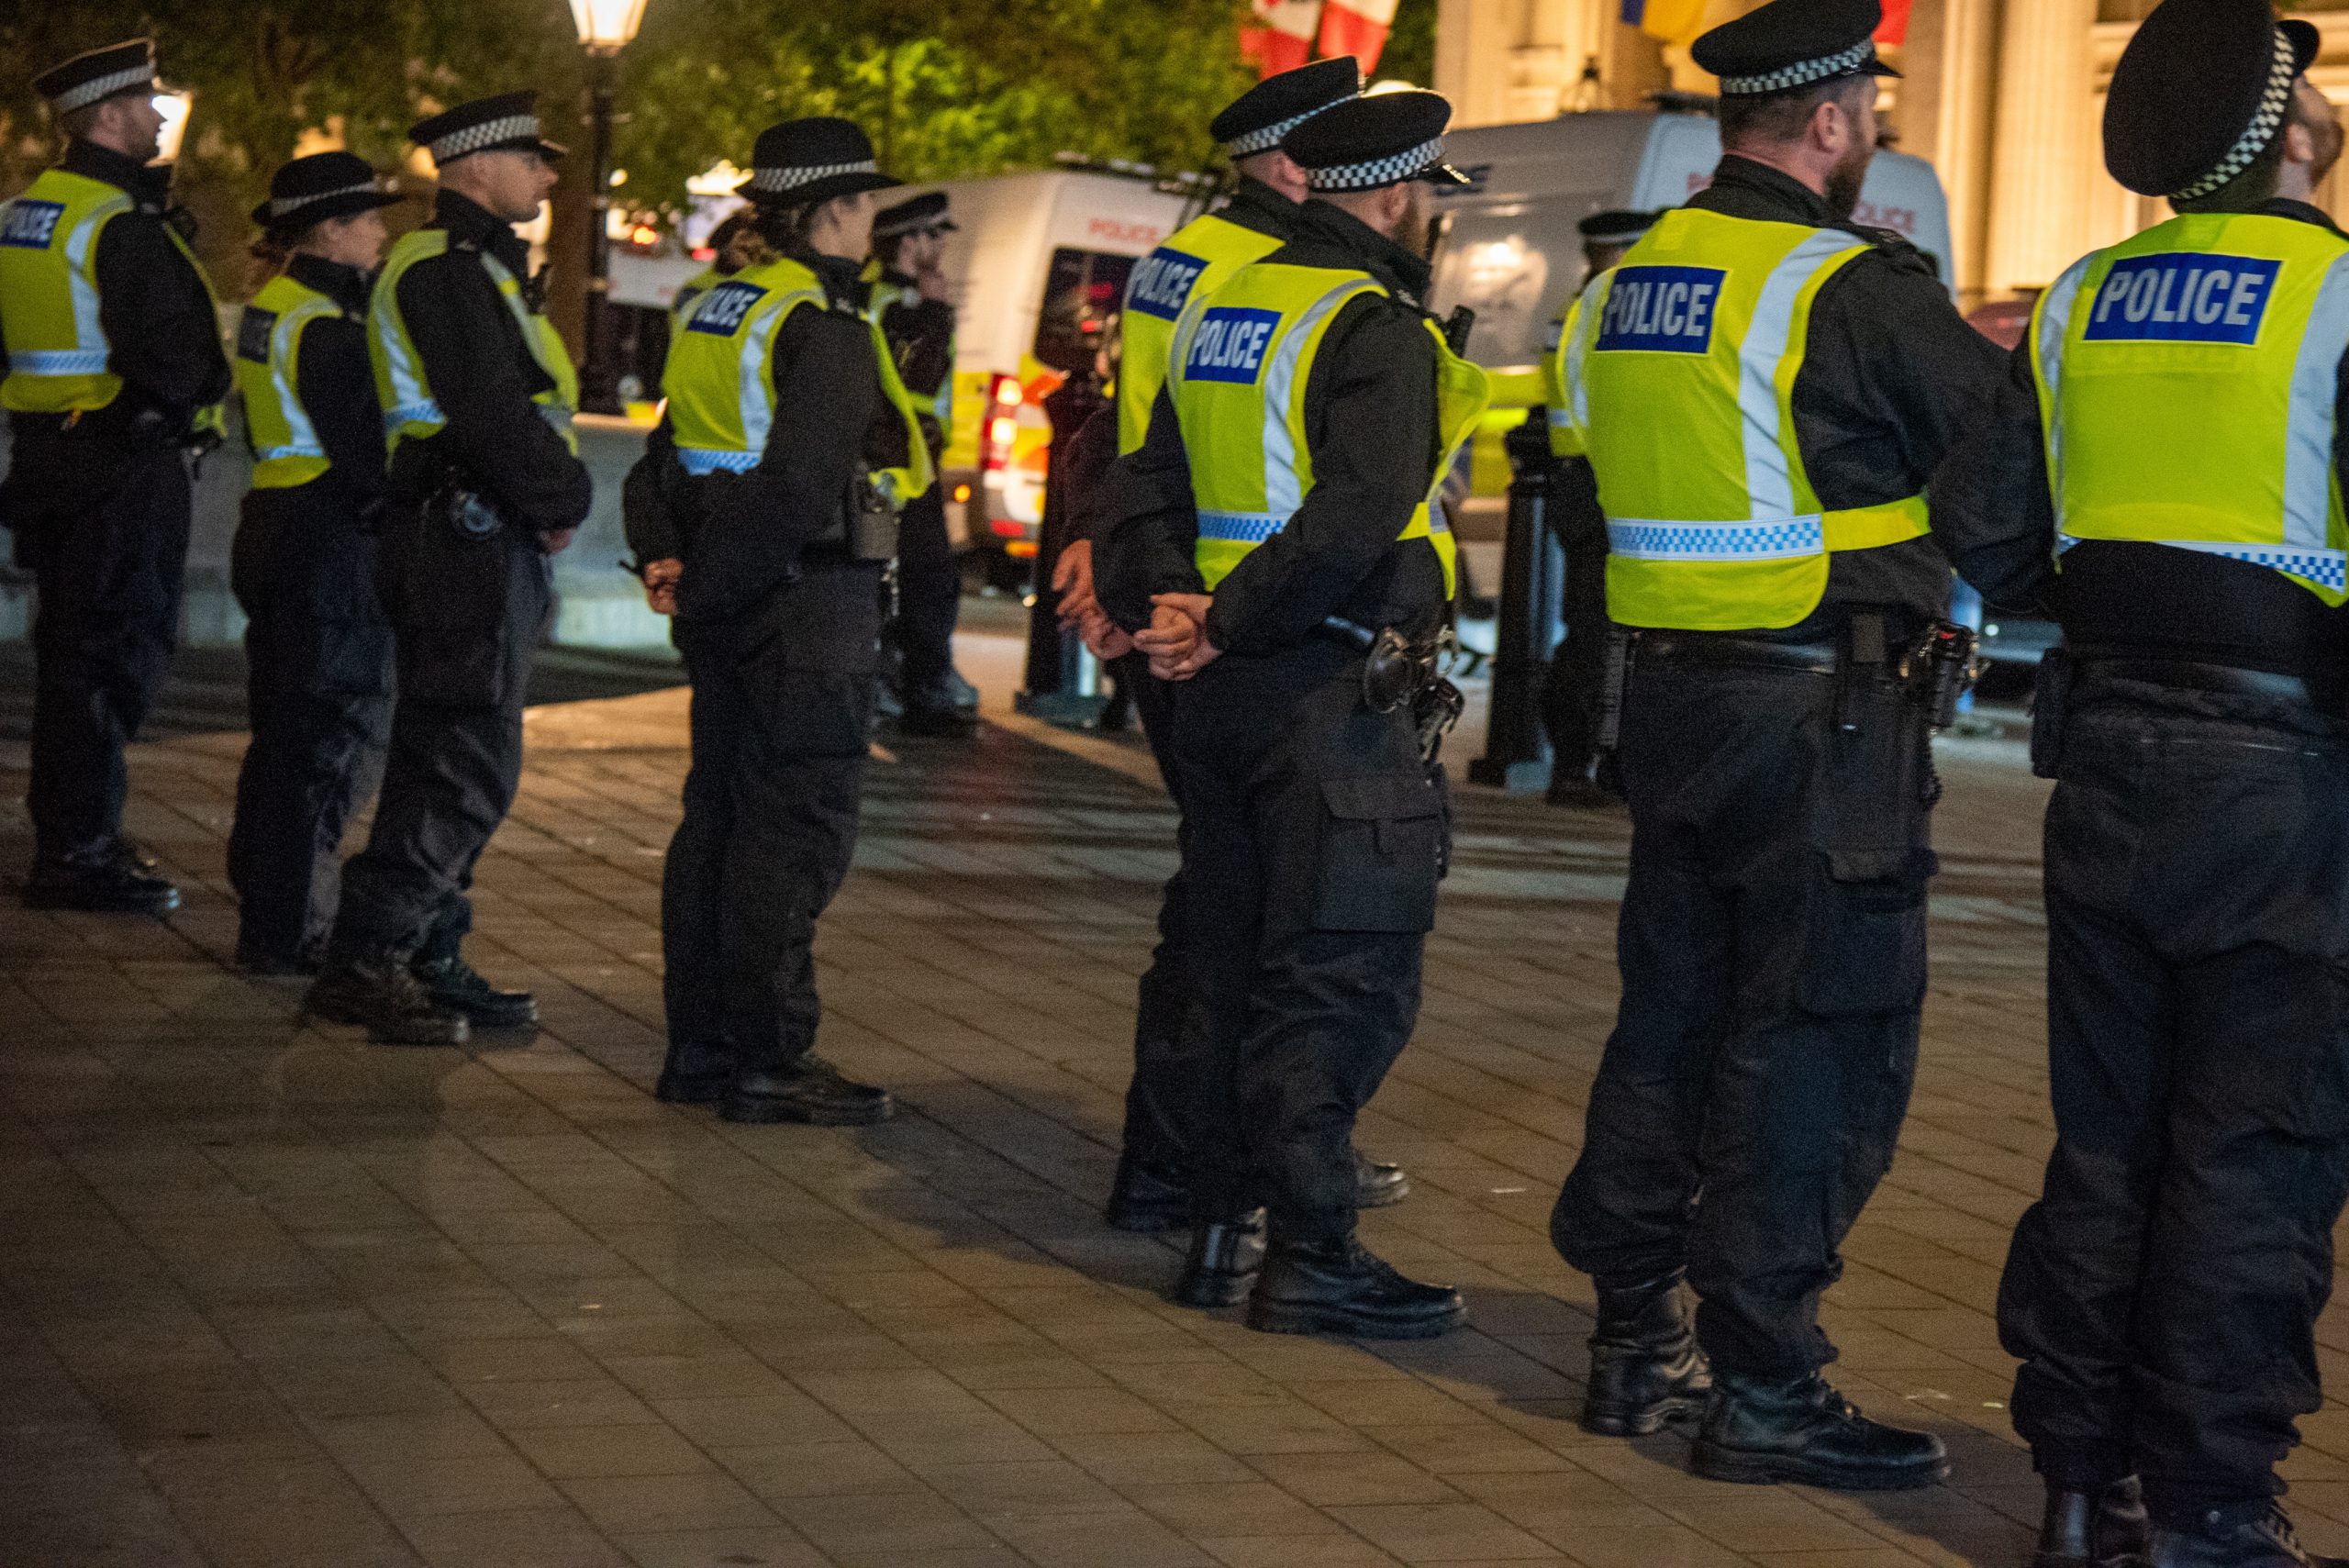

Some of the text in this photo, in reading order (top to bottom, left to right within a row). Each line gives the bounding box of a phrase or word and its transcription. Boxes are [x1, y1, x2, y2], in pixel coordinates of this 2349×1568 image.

[5, 206, 60, 240] OLICE
[1127, 257, 1199, 309] POLICE
[2096, 268, 2266, 326] POLICE
[1602, 282, 1714, 337] POLICE
[1187, 318, 1271, 369] POLICE
